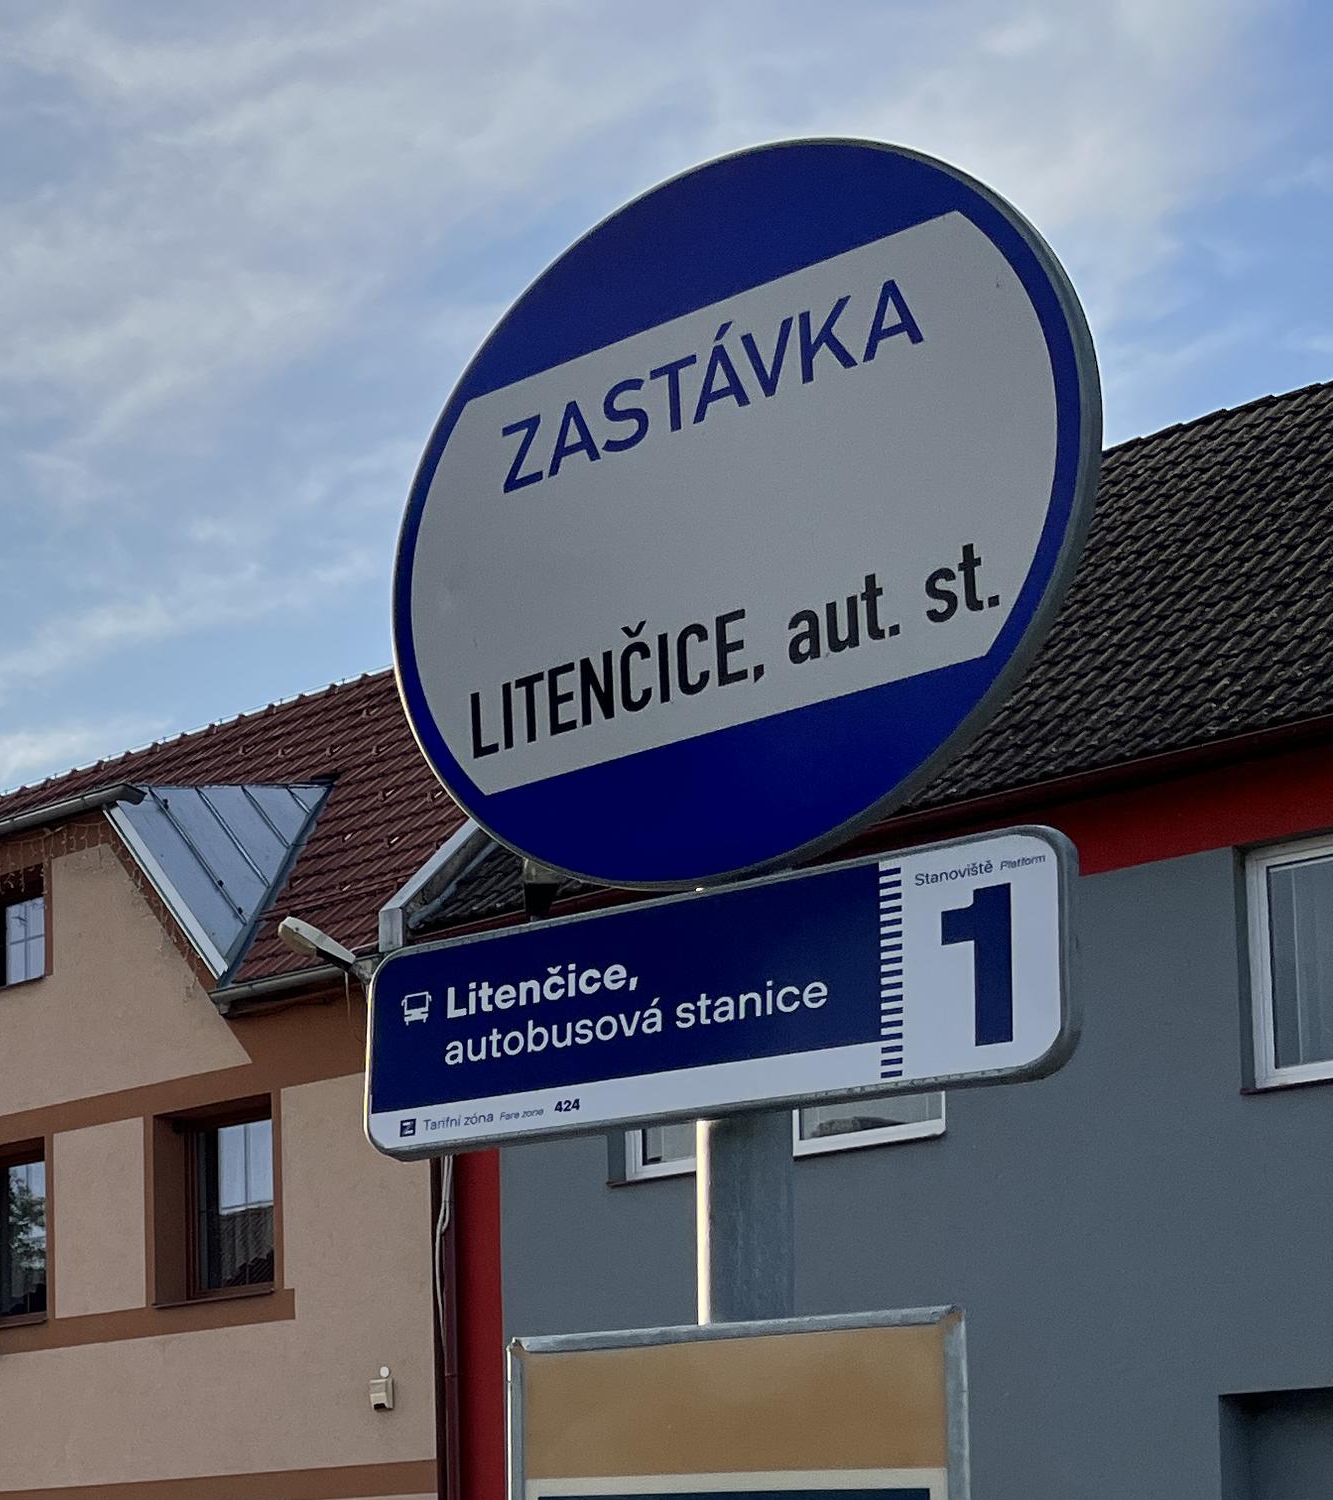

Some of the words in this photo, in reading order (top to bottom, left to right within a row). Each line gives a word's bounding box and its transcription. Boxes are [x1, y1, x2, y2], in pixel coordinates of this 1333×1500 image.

[502, 279, 924, 493] ZASTÁVKA
[469, 611, 765, 759] LITENČICE,
[788, 574, 900, 664] aut.
[925, 543, 1000, 624] st.
[915, 860, 993, 886] Stanoviště
[1000, 855, 1046, 870] Platform
[446, 963, 637, 1019] Litenčice,
[941, 883, 1013, 1047] 1
[444, 989, 663, 1066] autobusová
[675, 980, 828, 1029] stanice
[423, 1115, 461, 1131] Tarifní
[464, 1112, 493, 1126] zóna
[500, 1111, 519, 1121] Fare
[521, 1108, 544, 1118] zone
[554, 1099, 580, 1112] 424
